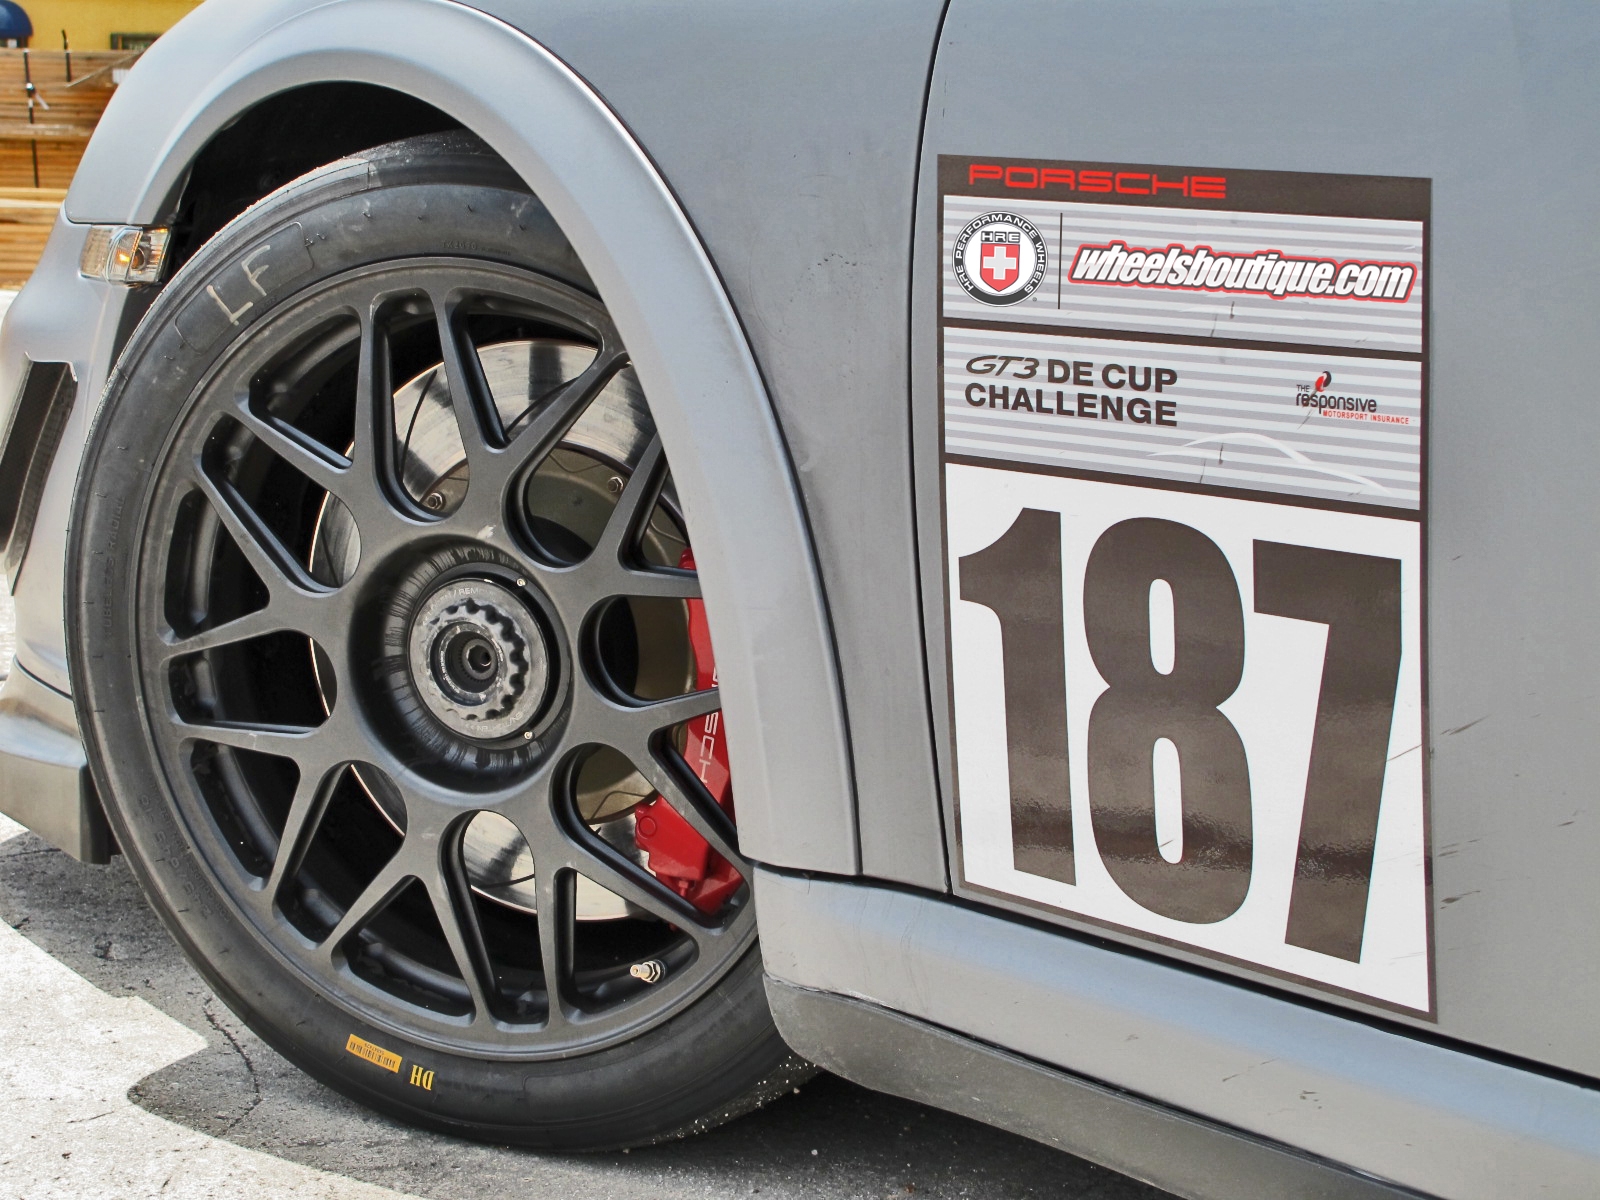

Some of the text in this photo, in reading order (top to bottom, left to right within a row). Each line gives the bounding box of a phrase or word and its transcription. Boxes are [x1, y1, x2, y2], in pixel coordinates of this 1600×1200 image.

[969, 163, 1226, 199] PORSCHE
[955, 213, 1045, 294] HRE PERFORMANCE WHEELS
[981, 231, 1021, 243] HRE
[1071, 243, 1416, 299] wheelsboutique.com
[965, 354, 1178, 393] GT3 DE CUP
[1296, 384, 1311, 393] THE
[964, 382, 1177, 427] CHALLENGE
[1295, 393, 1377, 414] responsive
[1322, 409, 1410, 425] MOTORSPORT INSURANCE
[958, 507, 1403, 964] 187
[409, 1064, 435, 1091] DH
